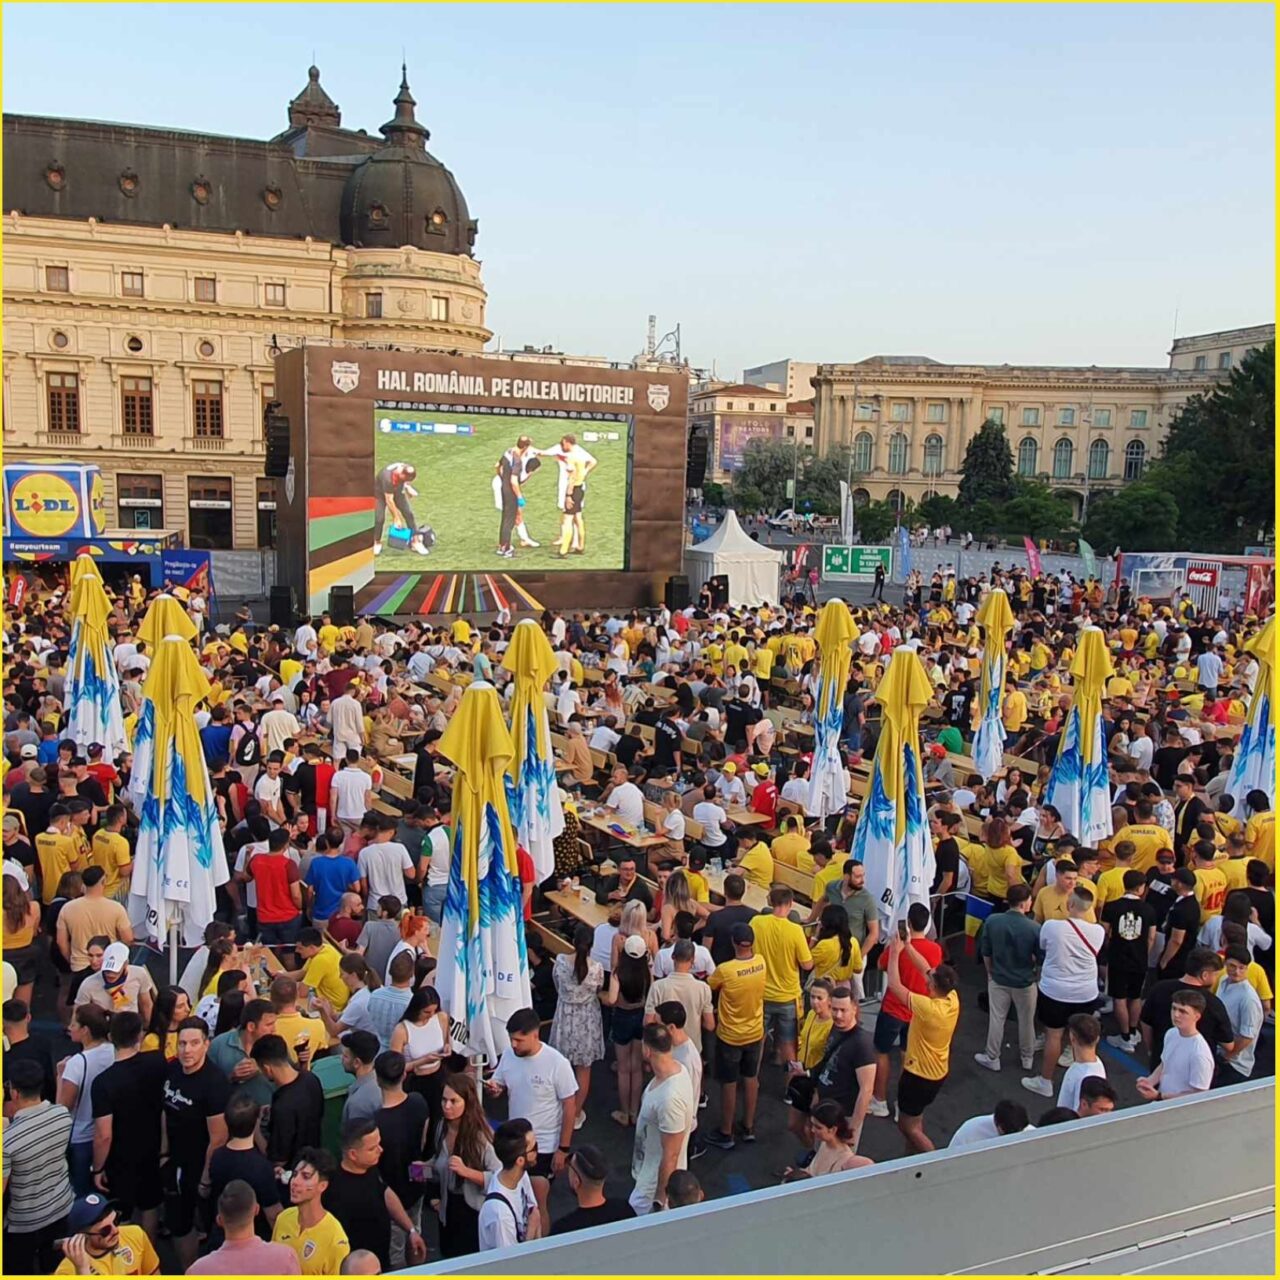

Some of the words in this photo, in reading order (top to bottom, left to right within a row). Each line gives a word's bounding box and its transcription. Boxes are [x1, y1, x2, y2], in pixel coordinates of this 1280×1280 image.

[377, 369, 411, 392] HAI,
[413, 370, 489, 397] ROMÂNIA,
[491, 377, 511, 397] PE
[513, 379, 562, 401] CALEA
[562, 383, 634, 405] VICTORIEI!
